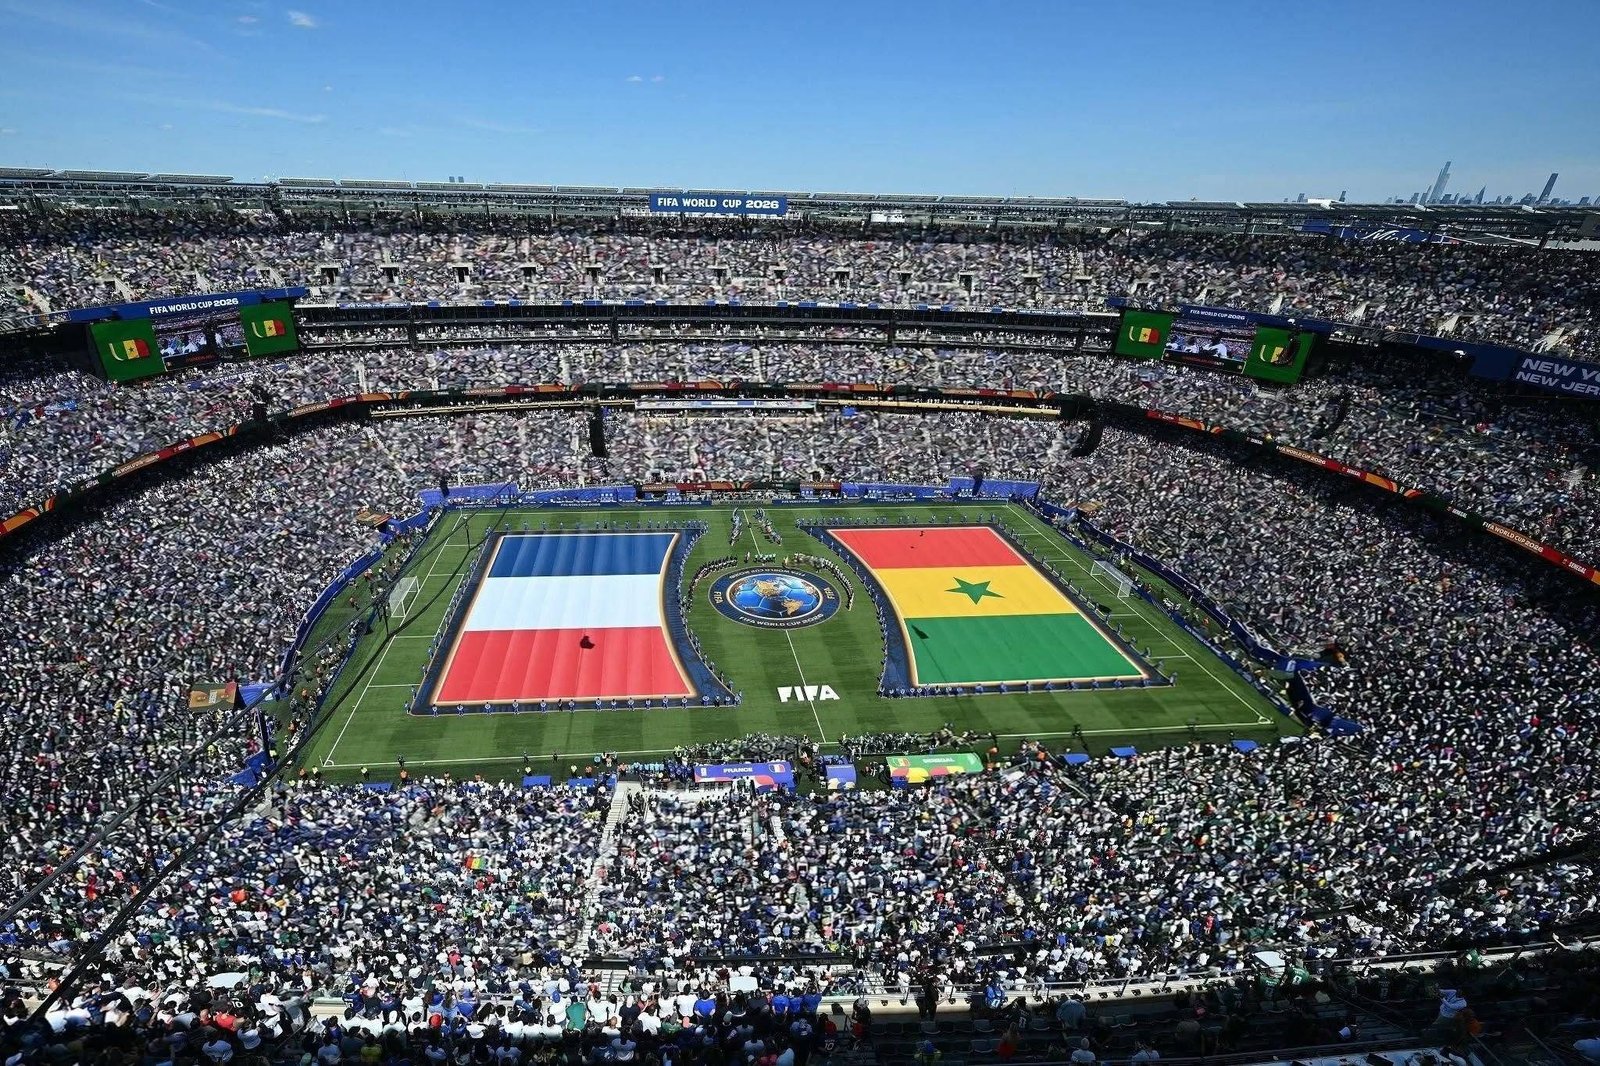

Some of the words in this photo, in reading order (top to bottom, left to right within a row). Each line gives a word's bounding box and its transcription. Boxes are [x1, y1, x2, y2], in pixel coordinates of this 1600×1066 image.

[657, 197, 679, 207] FIFA
[682, 198, 717, 208] WORLD
[722, 199, 742, 208] CUP
[745, 200, 779, 209] 2026
[149, 305, 169, 315] FIFA
[168, 302, 197, 313] WORLD
[197, 301, 213, 309] CUP
[213, 298, 239, 307] 2026
[1521, 358, 1577, 377] NEW
[1515, 371, 1560, 387] NEW
[1482, 521, 1495, 530] FIFA
[1494, 526, 1515, 539] WORLD
[1514, 535, 1526, 544] CUP
[1525, 540, 1544, 552] 2026
[714, 591, 724, 604] FIFA
[739, 616, 756, 624] FIFA
[801, 613, 824, 624] 2026
[777, 684, 841, 703] FIFA
